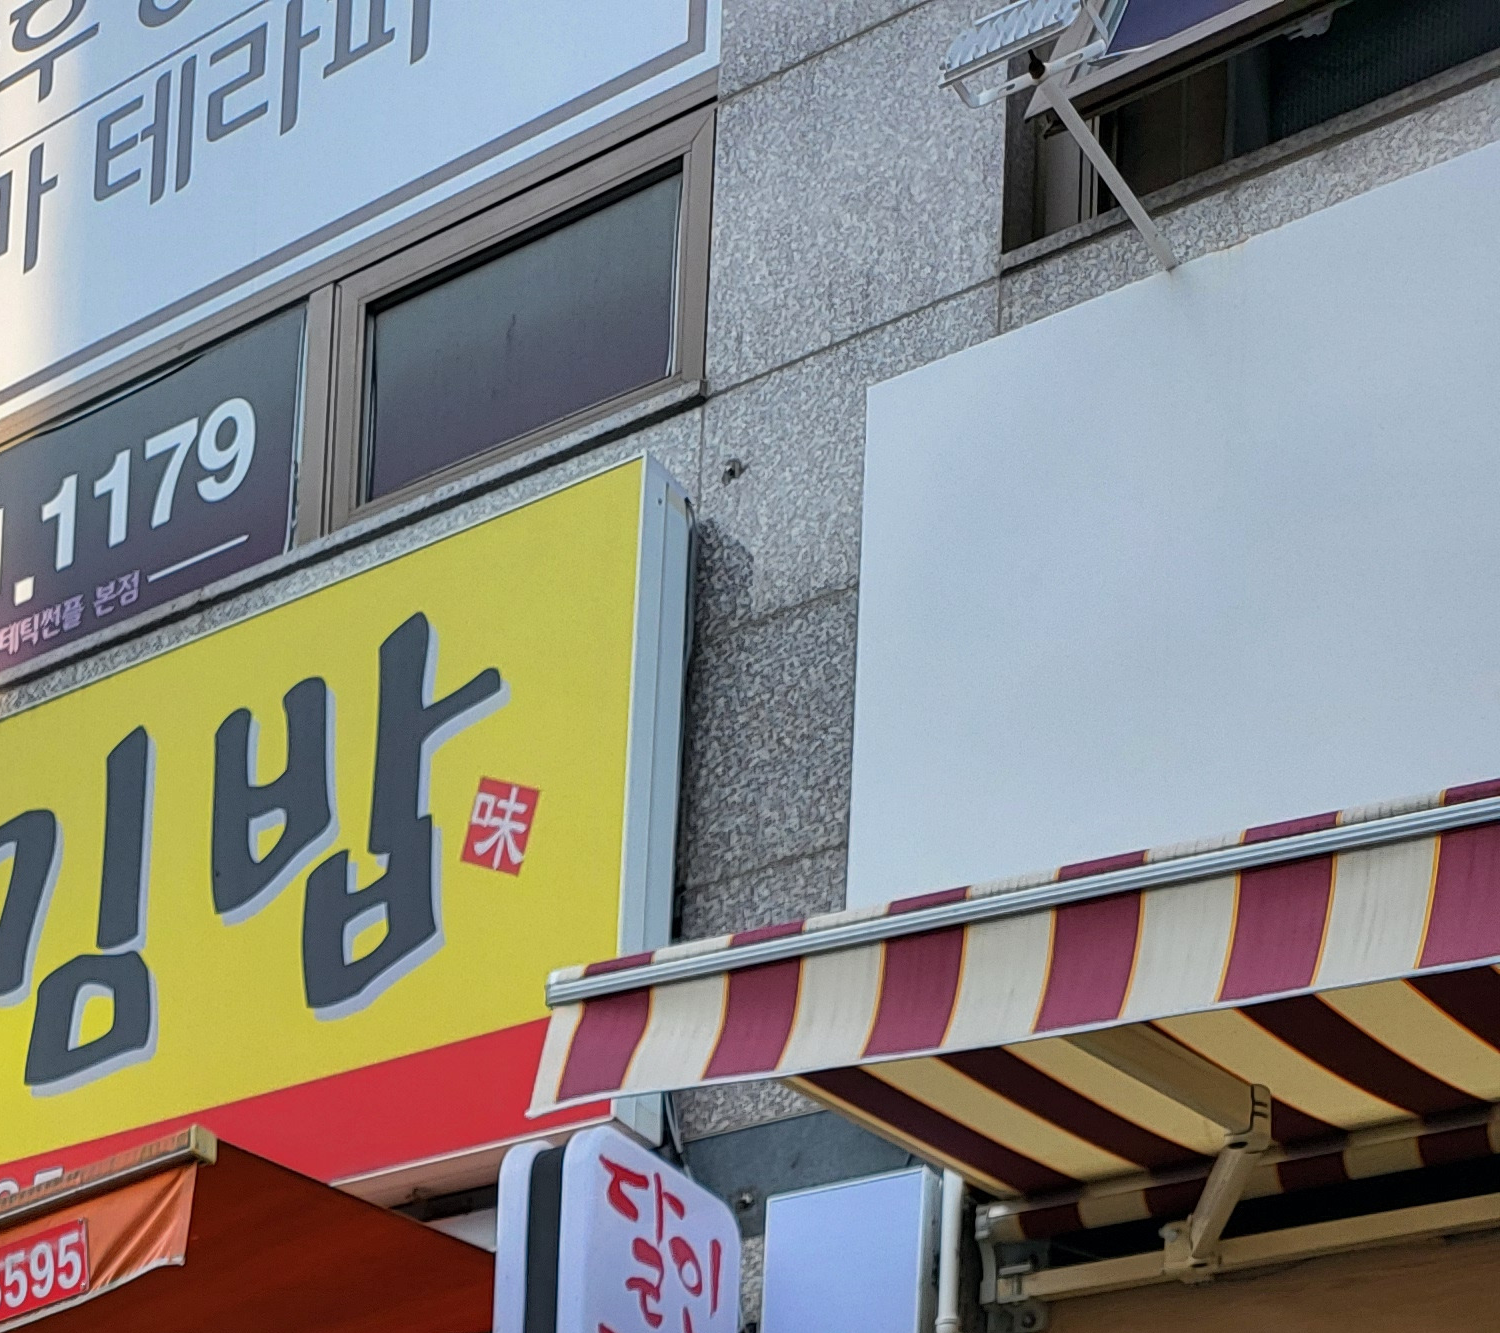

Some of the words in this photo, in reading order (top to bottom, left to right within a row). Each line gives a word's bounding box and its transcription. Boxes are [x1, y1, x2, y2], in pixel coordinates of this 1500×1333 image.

[93, 0, 432, 206] 테라피
[93, 569, 141, 619] 본점
[470, 788, 534, 871] 味
